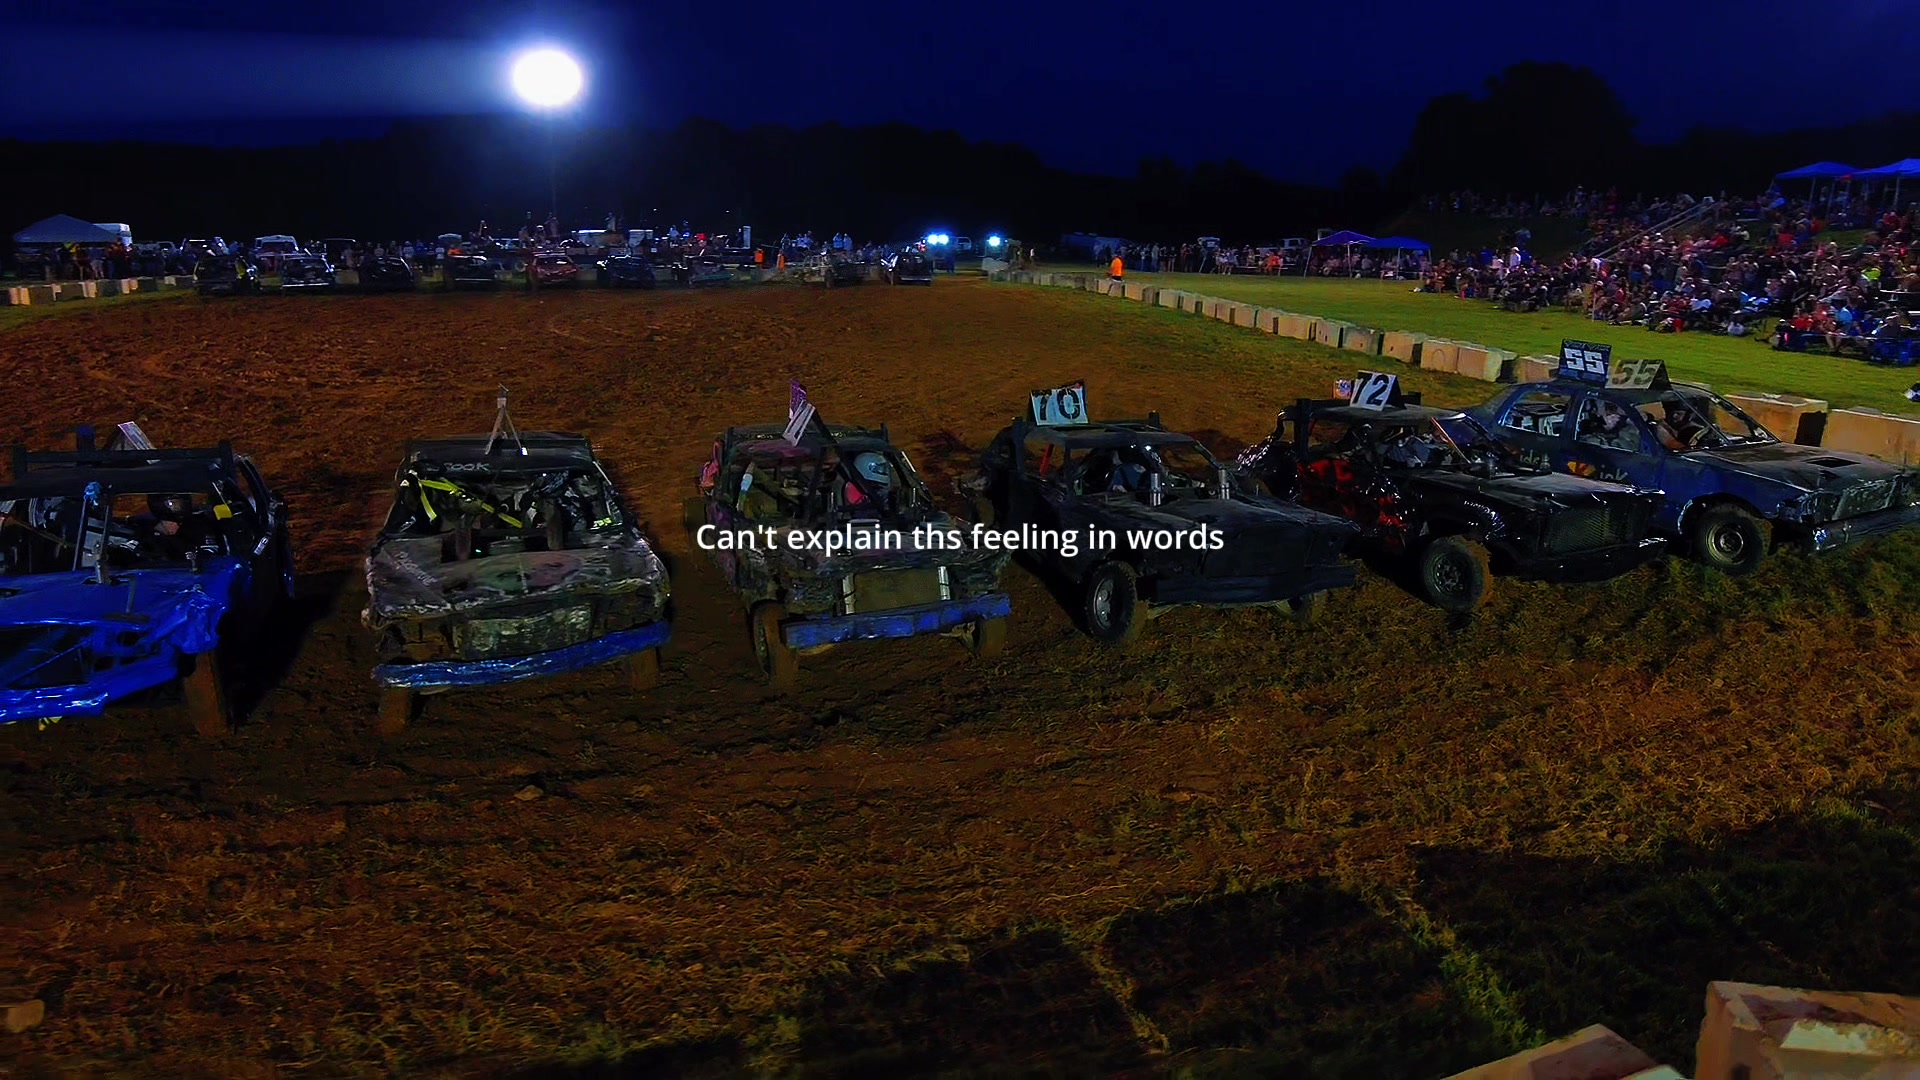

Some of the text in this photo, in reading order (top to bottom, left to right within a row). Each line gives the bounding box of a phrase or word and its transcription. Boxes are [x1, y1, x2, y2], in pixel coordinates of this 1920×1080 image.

[1563, 347, 1605, 375] 55
[1612, 360, 1656, 385] 55
[1352, 372, 1389, 406] 72
[1032, 388, 1081, 421] 70
